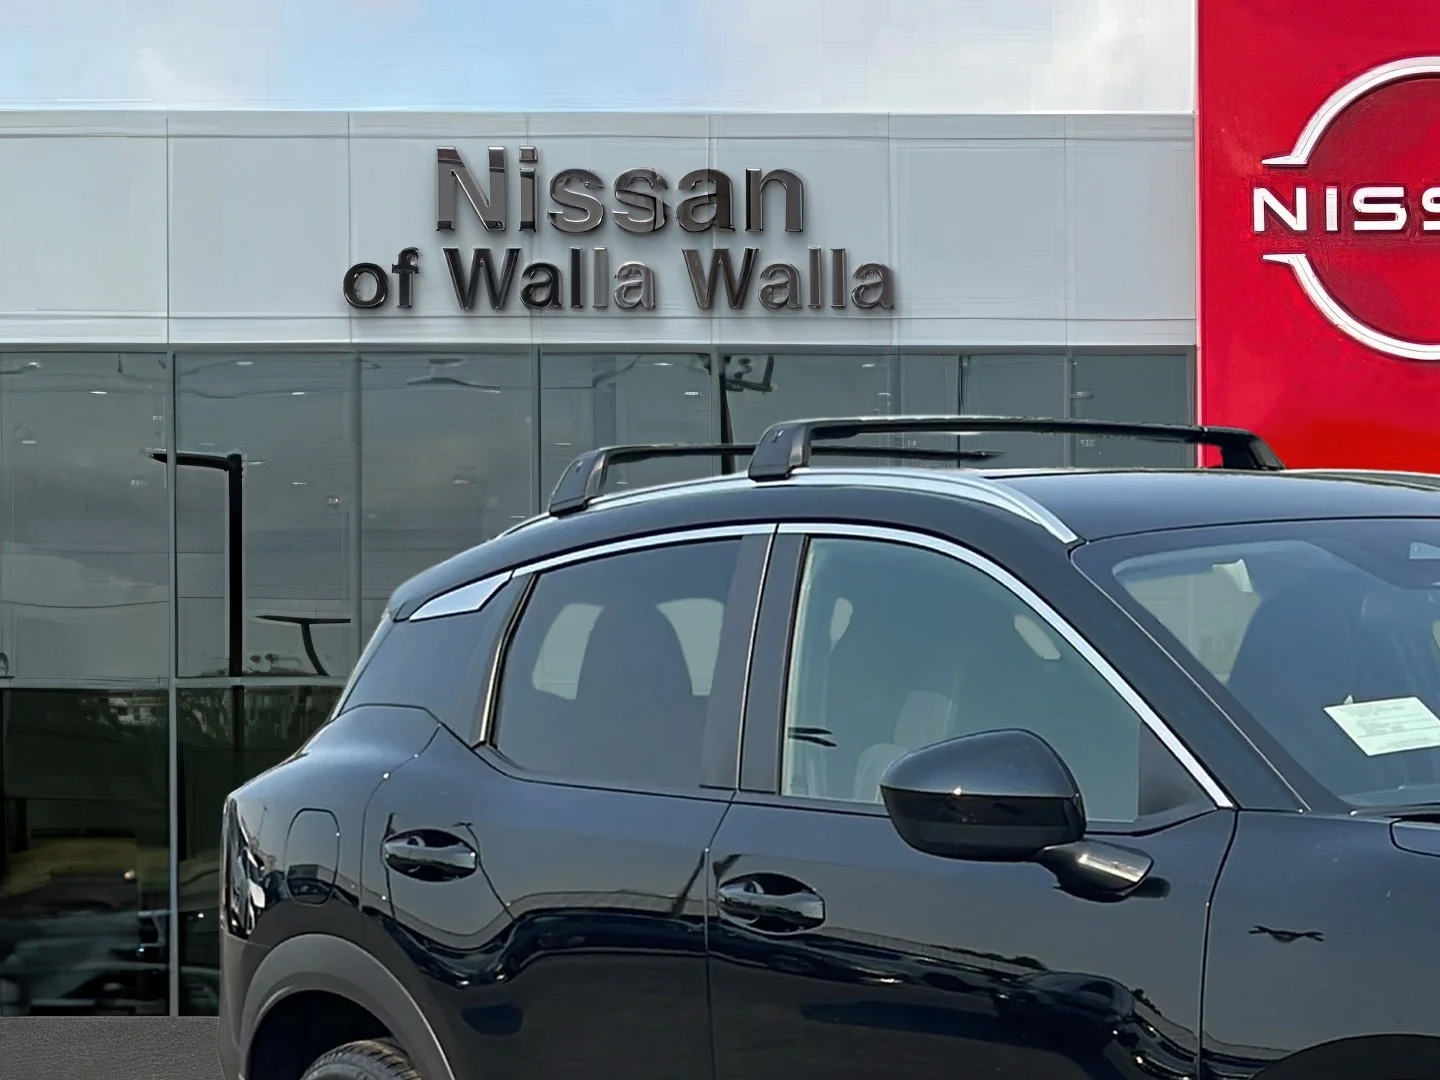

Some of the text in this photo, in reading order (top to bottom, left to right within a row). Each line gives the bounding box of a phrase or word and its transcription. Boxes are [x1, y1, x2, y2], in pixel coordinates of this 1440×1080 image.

[434, 145, 807, 233] Nissan
[343, 244, 894, 310] of Walla Walla
